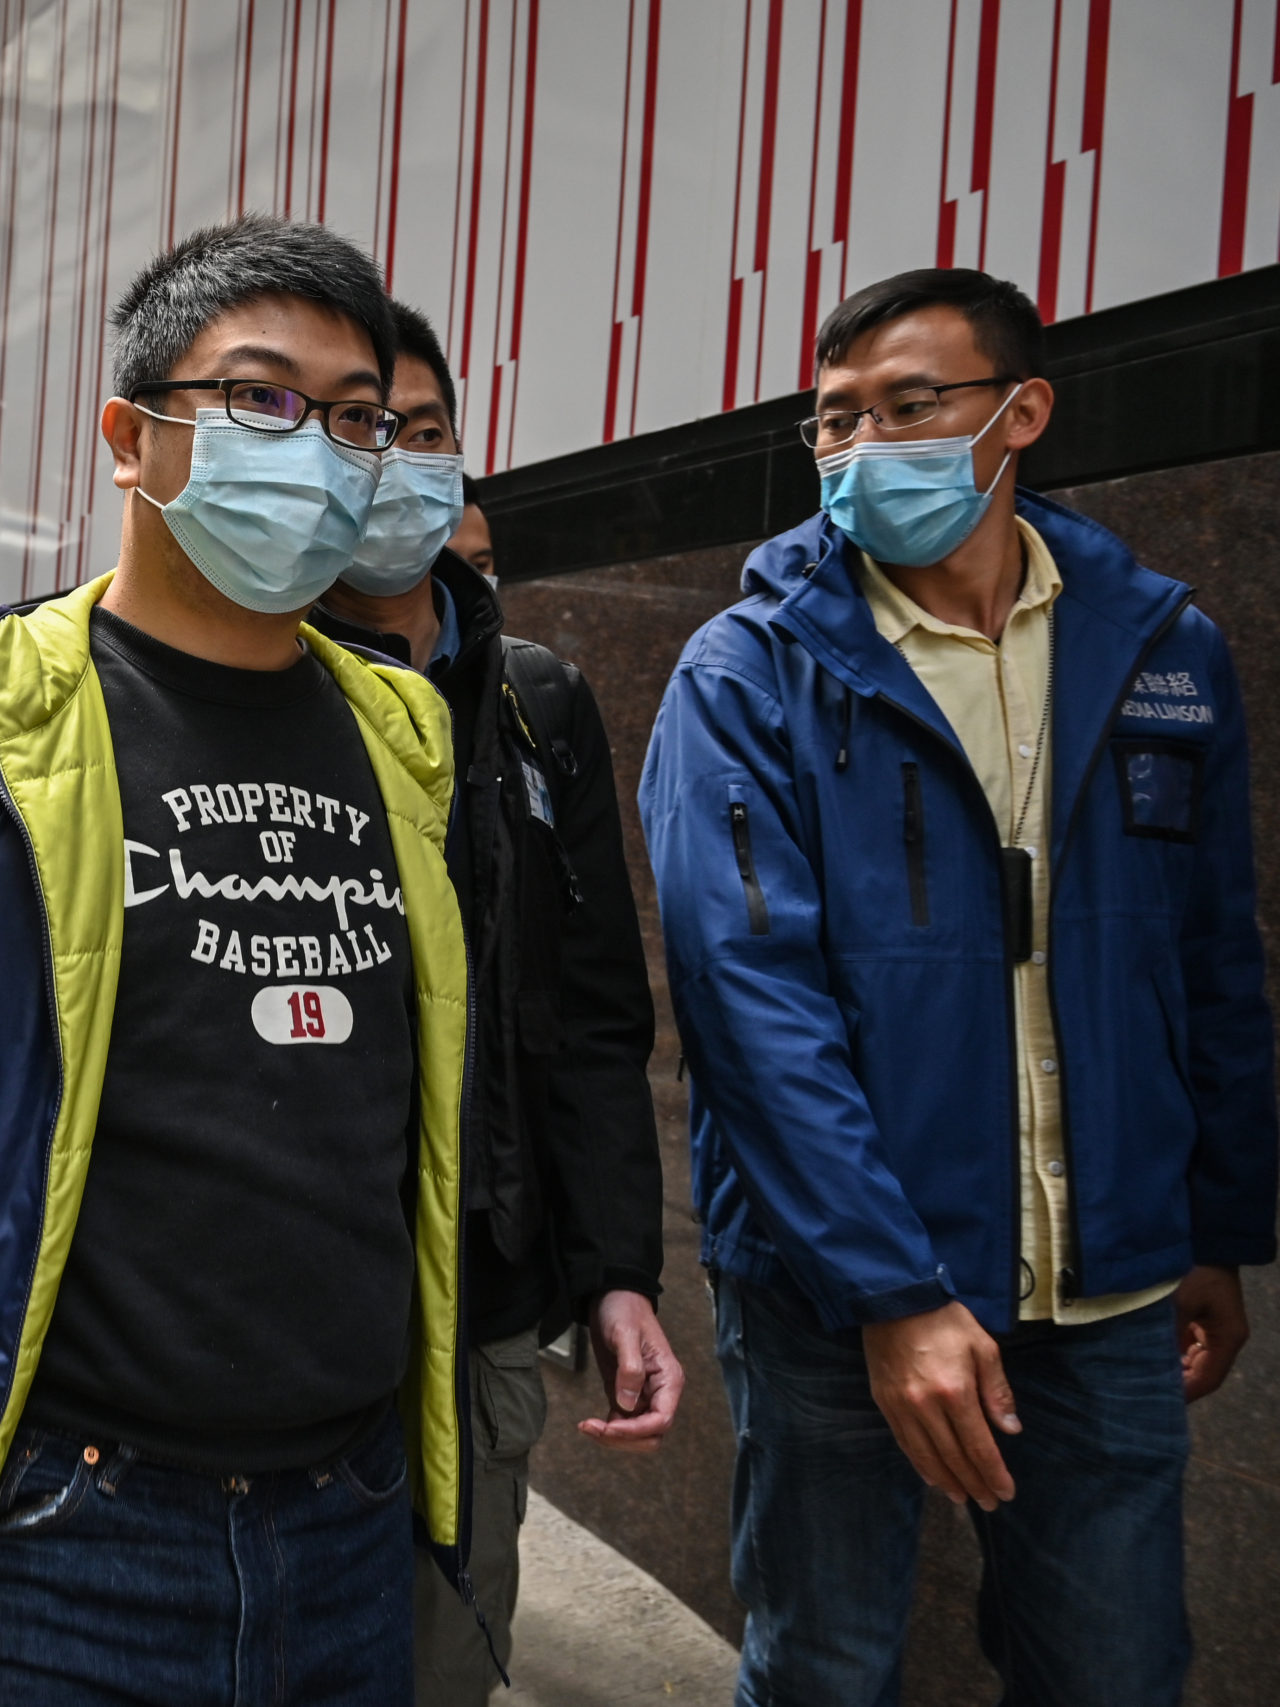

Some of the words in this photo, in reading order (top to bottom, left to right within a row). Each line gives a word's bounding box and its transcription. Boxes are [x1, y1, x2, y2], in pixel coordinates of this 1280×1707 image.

[1154, 702, 1214, 724] LIAISON
[161, 782, 370, 846] PROPERTY
[260, 830, 297, 863] OF
[190, 919, 392, 978] BASEBALL
[286, 991, 326, 1039] 19
